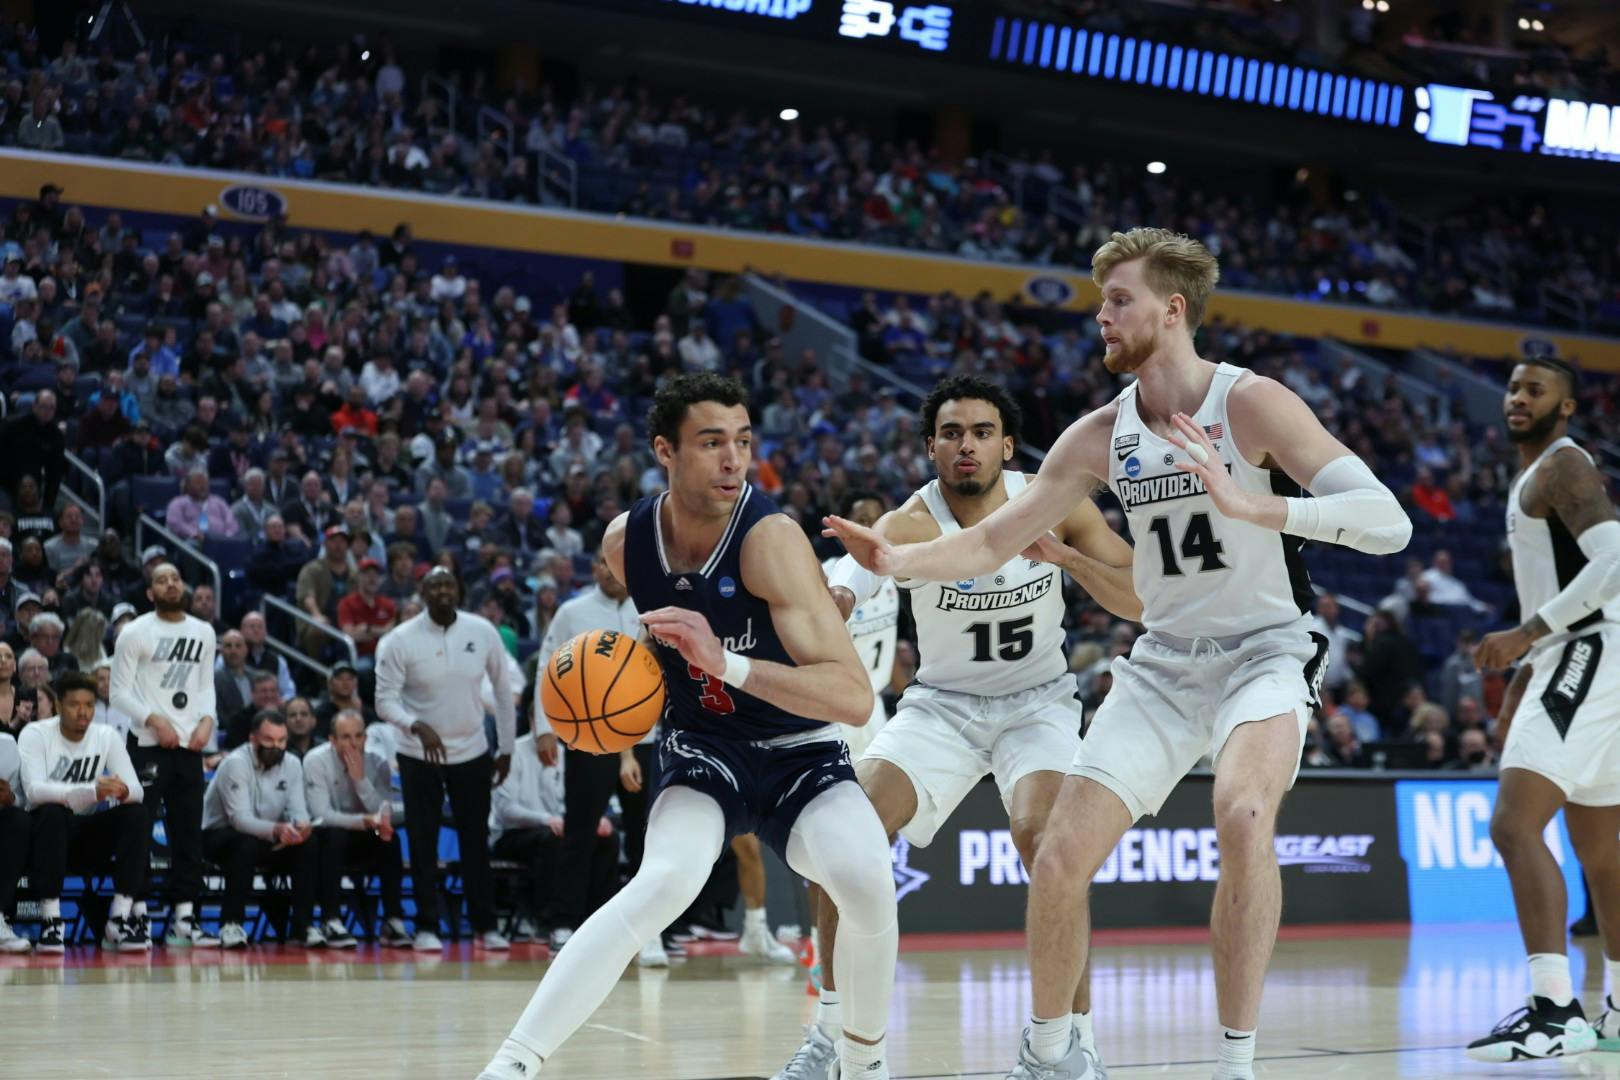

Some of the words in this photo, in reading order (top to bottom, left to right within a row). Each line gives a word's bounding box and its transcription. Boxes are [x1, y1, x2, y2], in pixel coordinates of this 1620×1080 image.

[1117, 463, 1232, 513] PROVIDEN
[1147, 511, 1232, 578] 14
[936, 571, 1054, 612] PROVIDENCE
[871, 639, 883, 671] 1
[961, 613, 1035, 662] 15
[688, 663, 735, 715] 3
[1556, 640, 1593, 700] FRIARS
[959, 828, 1221, 885] PRDENCE
[1413, 791, 1565, 870] NC
